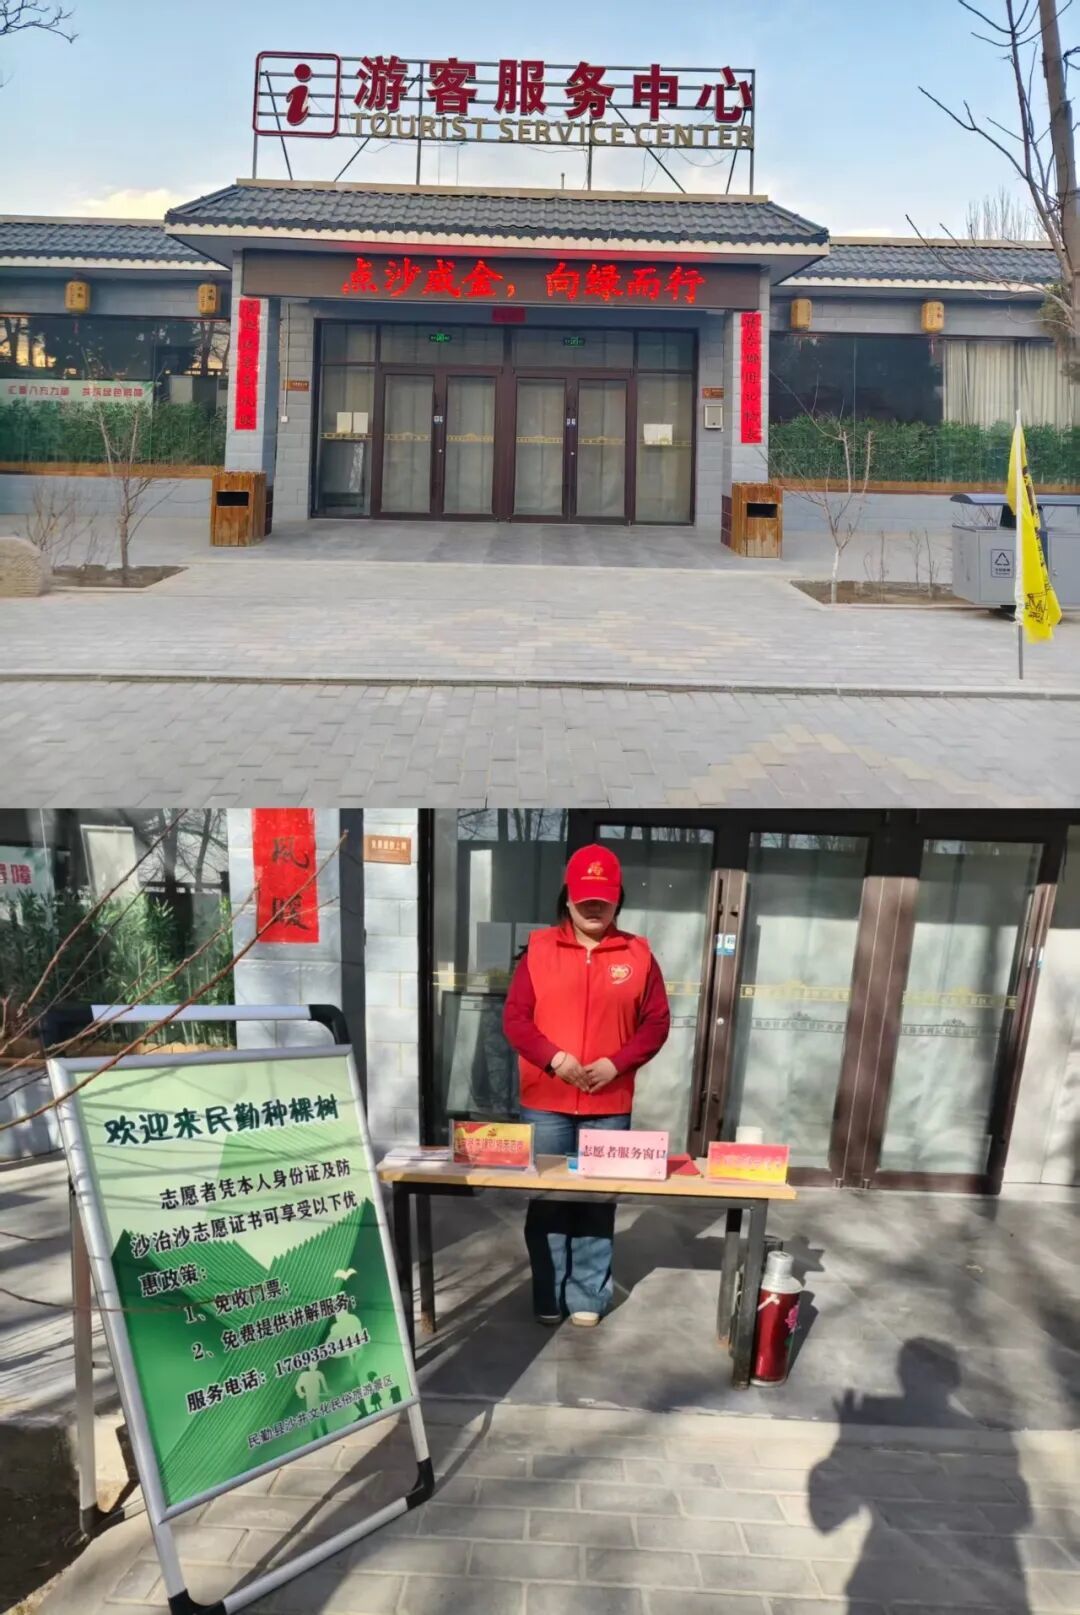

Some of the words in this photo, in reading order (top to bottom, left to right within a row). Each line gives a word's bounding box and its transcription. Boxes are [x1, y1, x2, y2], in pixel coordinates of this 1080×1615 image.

[354, 55, 753, 124] 游客服务中心
[350, 111, 489, 140] TOURIST
[498, 114, 625, 145] SERVICE
[634, 120, 755, 149] CENTER
[104, 1094, 339, 1146] 欢迎来民勤种棵树
[583, 1145, 666, 1160] 志愿者服务窗口
[159, 1159, 351, 1210] 志愿者凭本人身份证及防
[131, 1191, 358, 1258] 沙治沙志愿证书可享受以下优
[139, 1264, 208, 1297] 惠政策：
